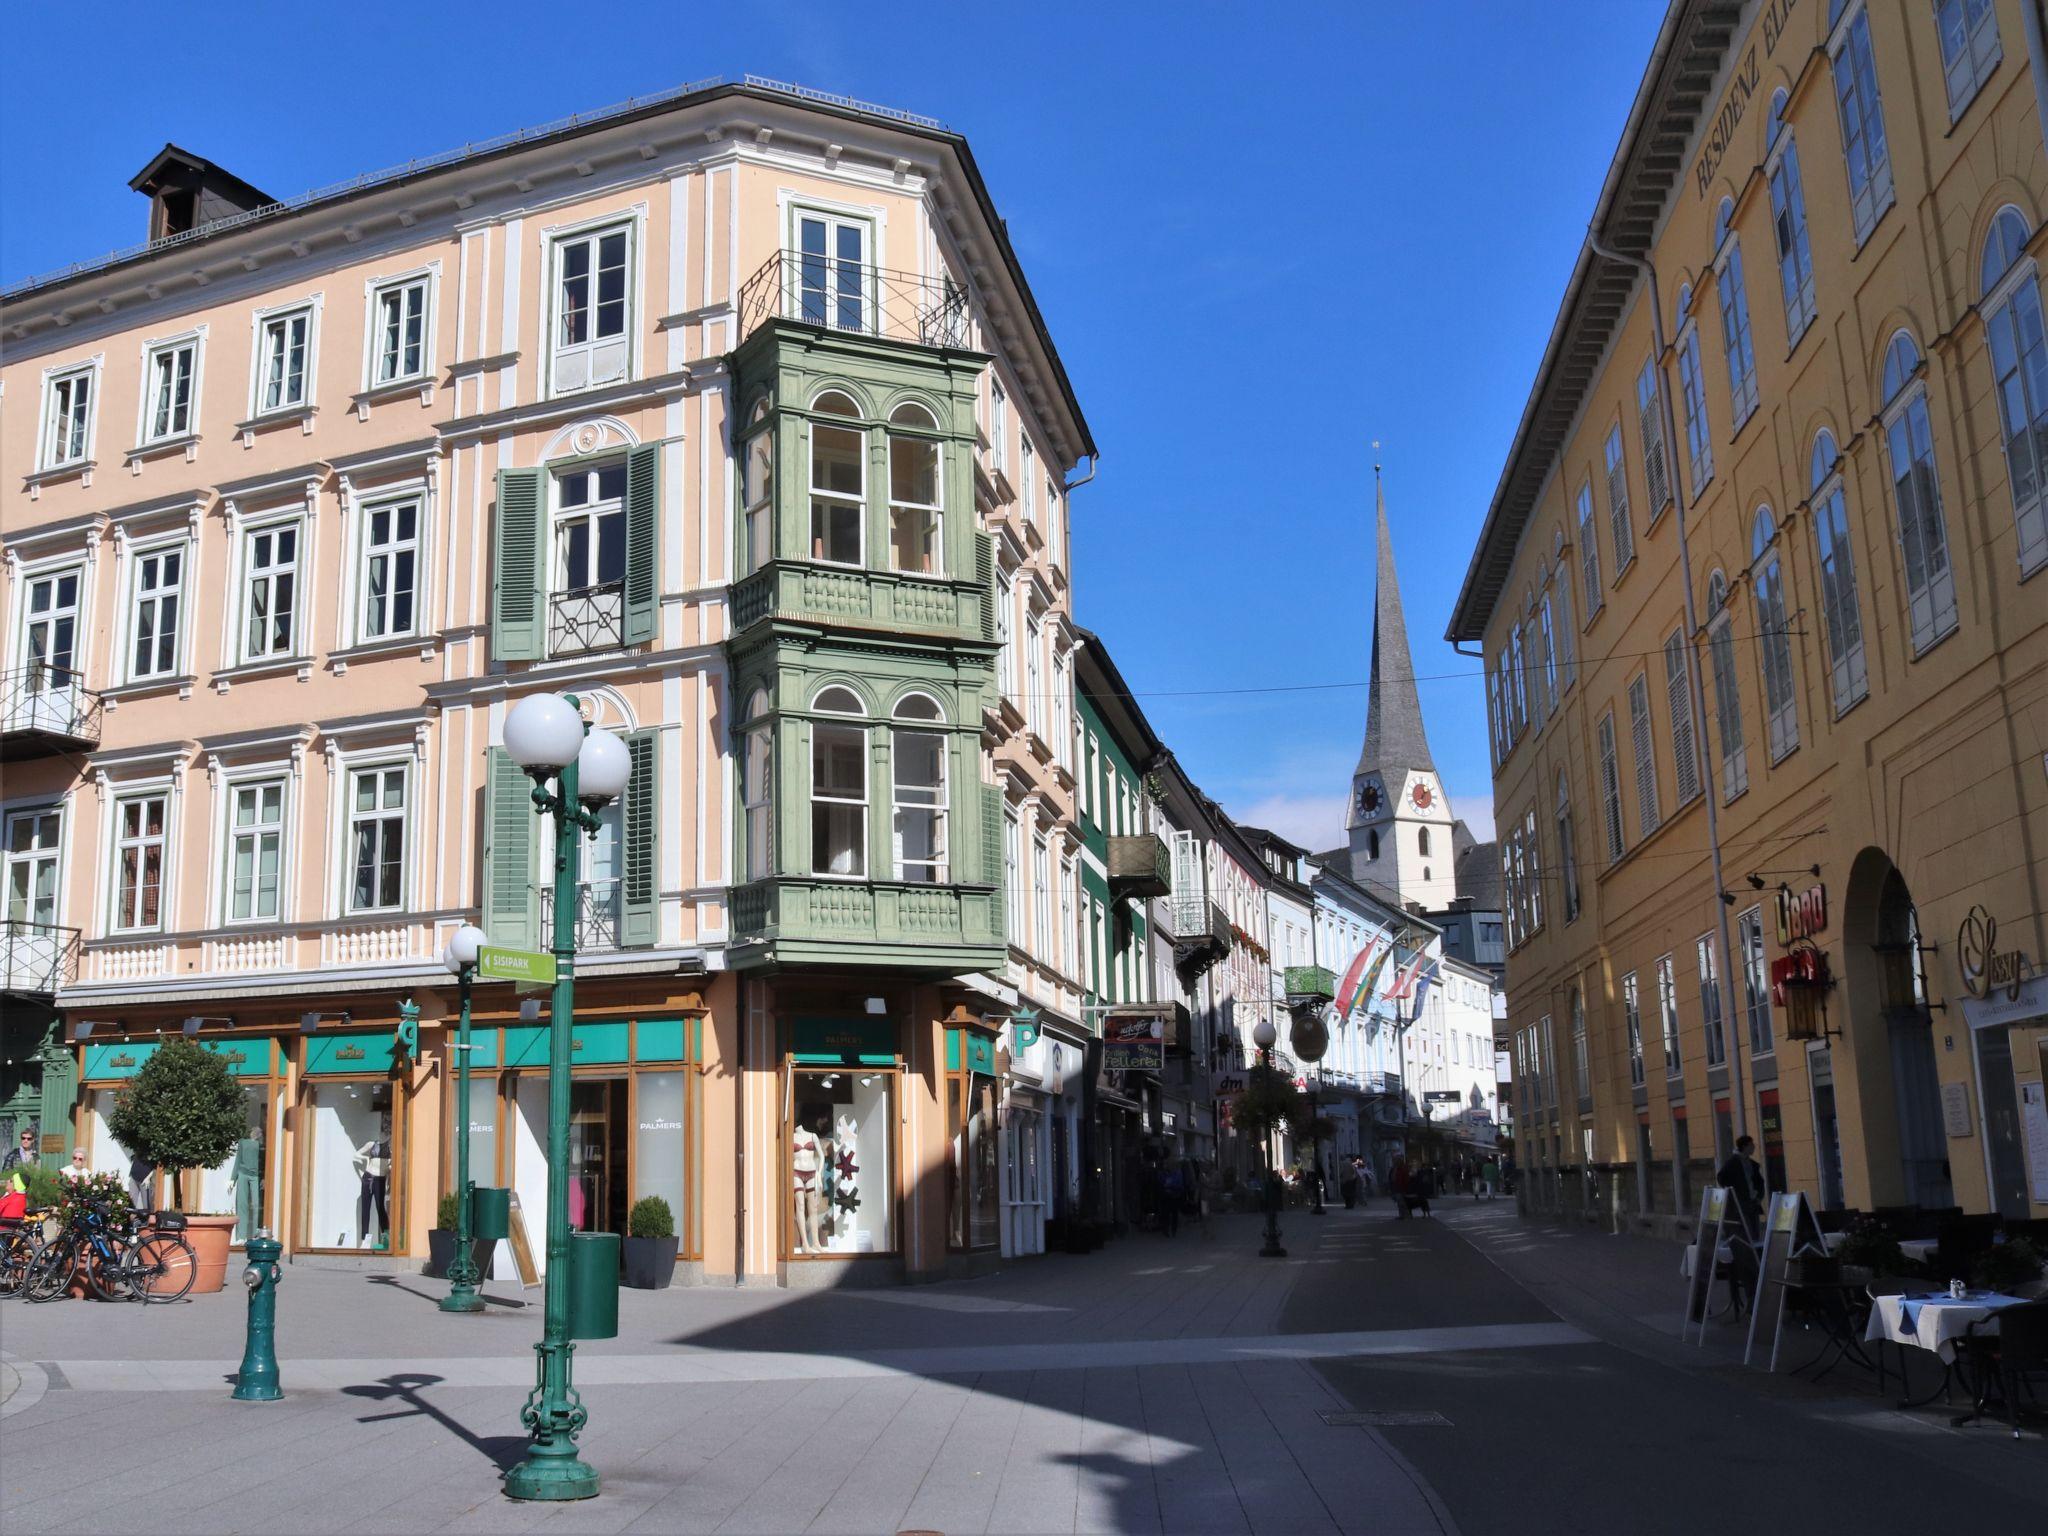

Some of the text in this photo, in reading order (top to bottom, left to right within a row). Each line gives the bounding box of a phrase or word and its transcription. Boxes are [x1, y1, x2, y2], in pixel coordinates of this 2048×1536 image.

[1695, 0, 1797, 201] RESIDENZ ELI
[493, 955, 529, 969] SISIPARK
[1015, 1024, 1039, 1058] P
[1220, 1076, 1243, 1089] dm
[455, 1125, 494, 1133] PMERS
[640, 1122, 682, 1130] PALMERS
